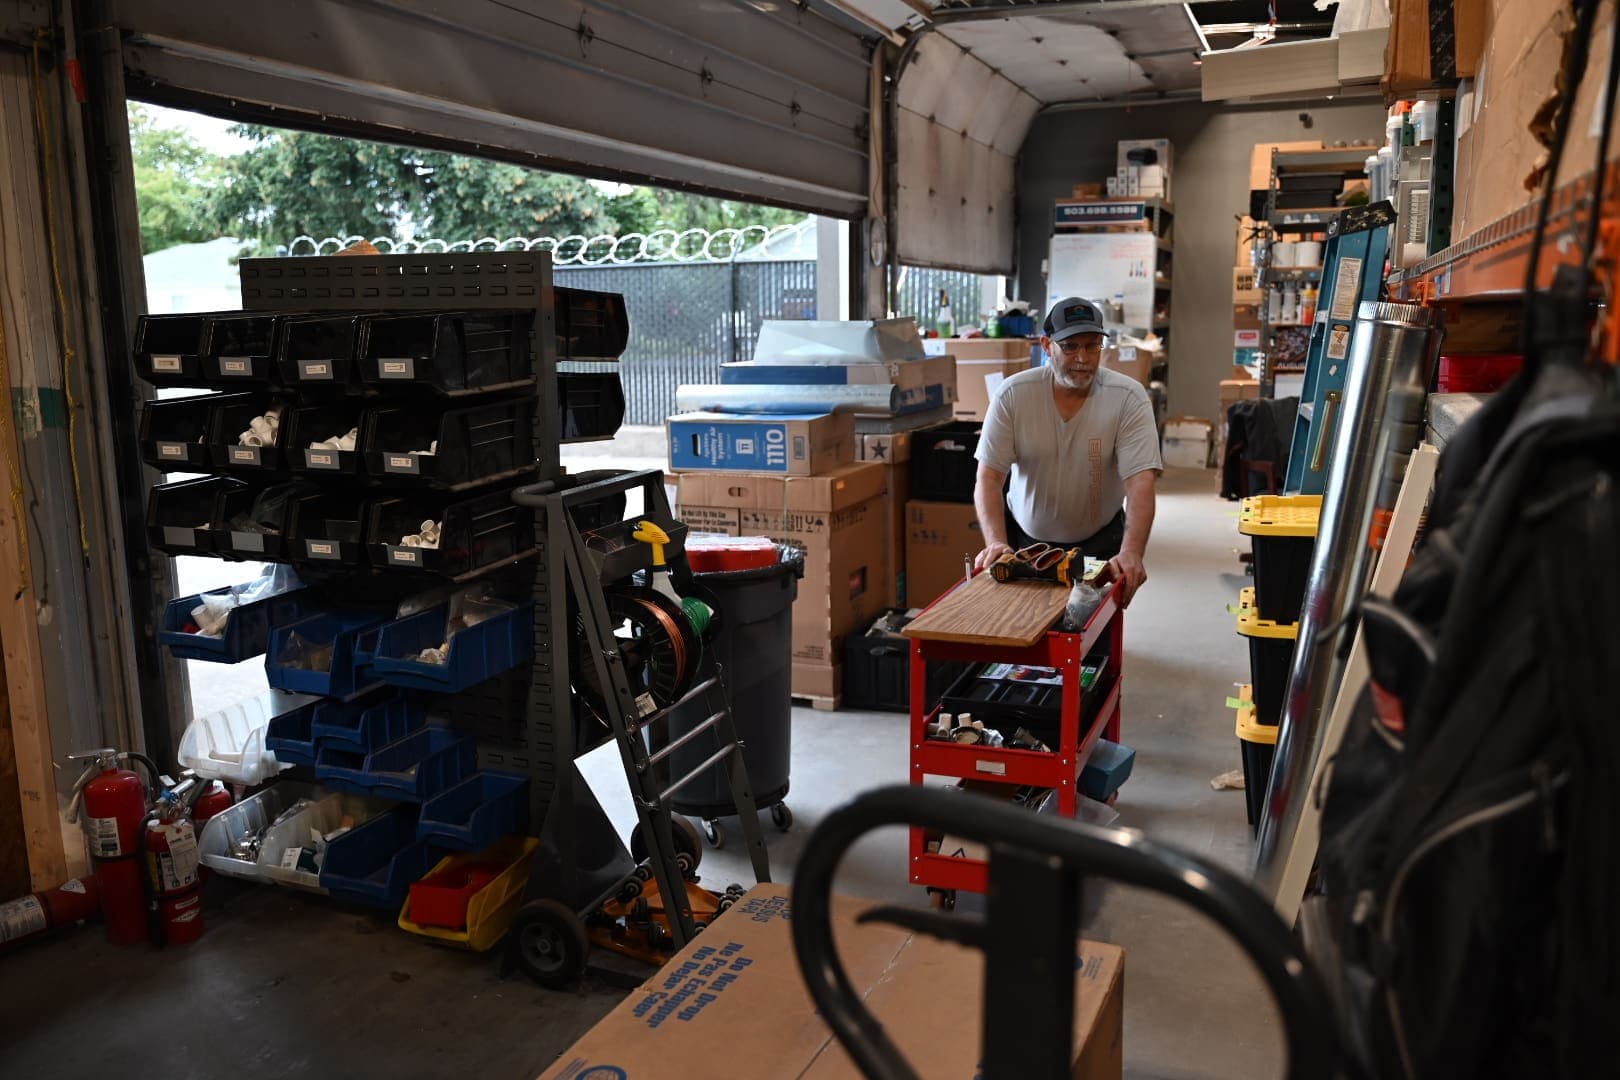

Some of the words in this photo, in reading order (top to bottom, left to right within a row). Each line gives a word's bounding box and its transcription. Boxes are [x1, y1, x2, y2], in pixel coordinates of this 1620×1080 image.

[710, 438, 718, 466] Healthy
[717, 432, 726, 460] System
[766, 428, 785, 466] 1110
[752, 895, 785, 922] DESSUS
[692, 946, 717, 960] No
[719, 942, 744, 956] Ne
[662, 961, 701, 990] Dejar
[698, 957, 728, 977] Pas
[729, 956, 754, 971] Do
[708, 972, 738, 992] Not
[632, 991, 667, 1018] Caer
[646, 978, 707, 1028] Echapper
[677, 992, 717, 1021] Drop
